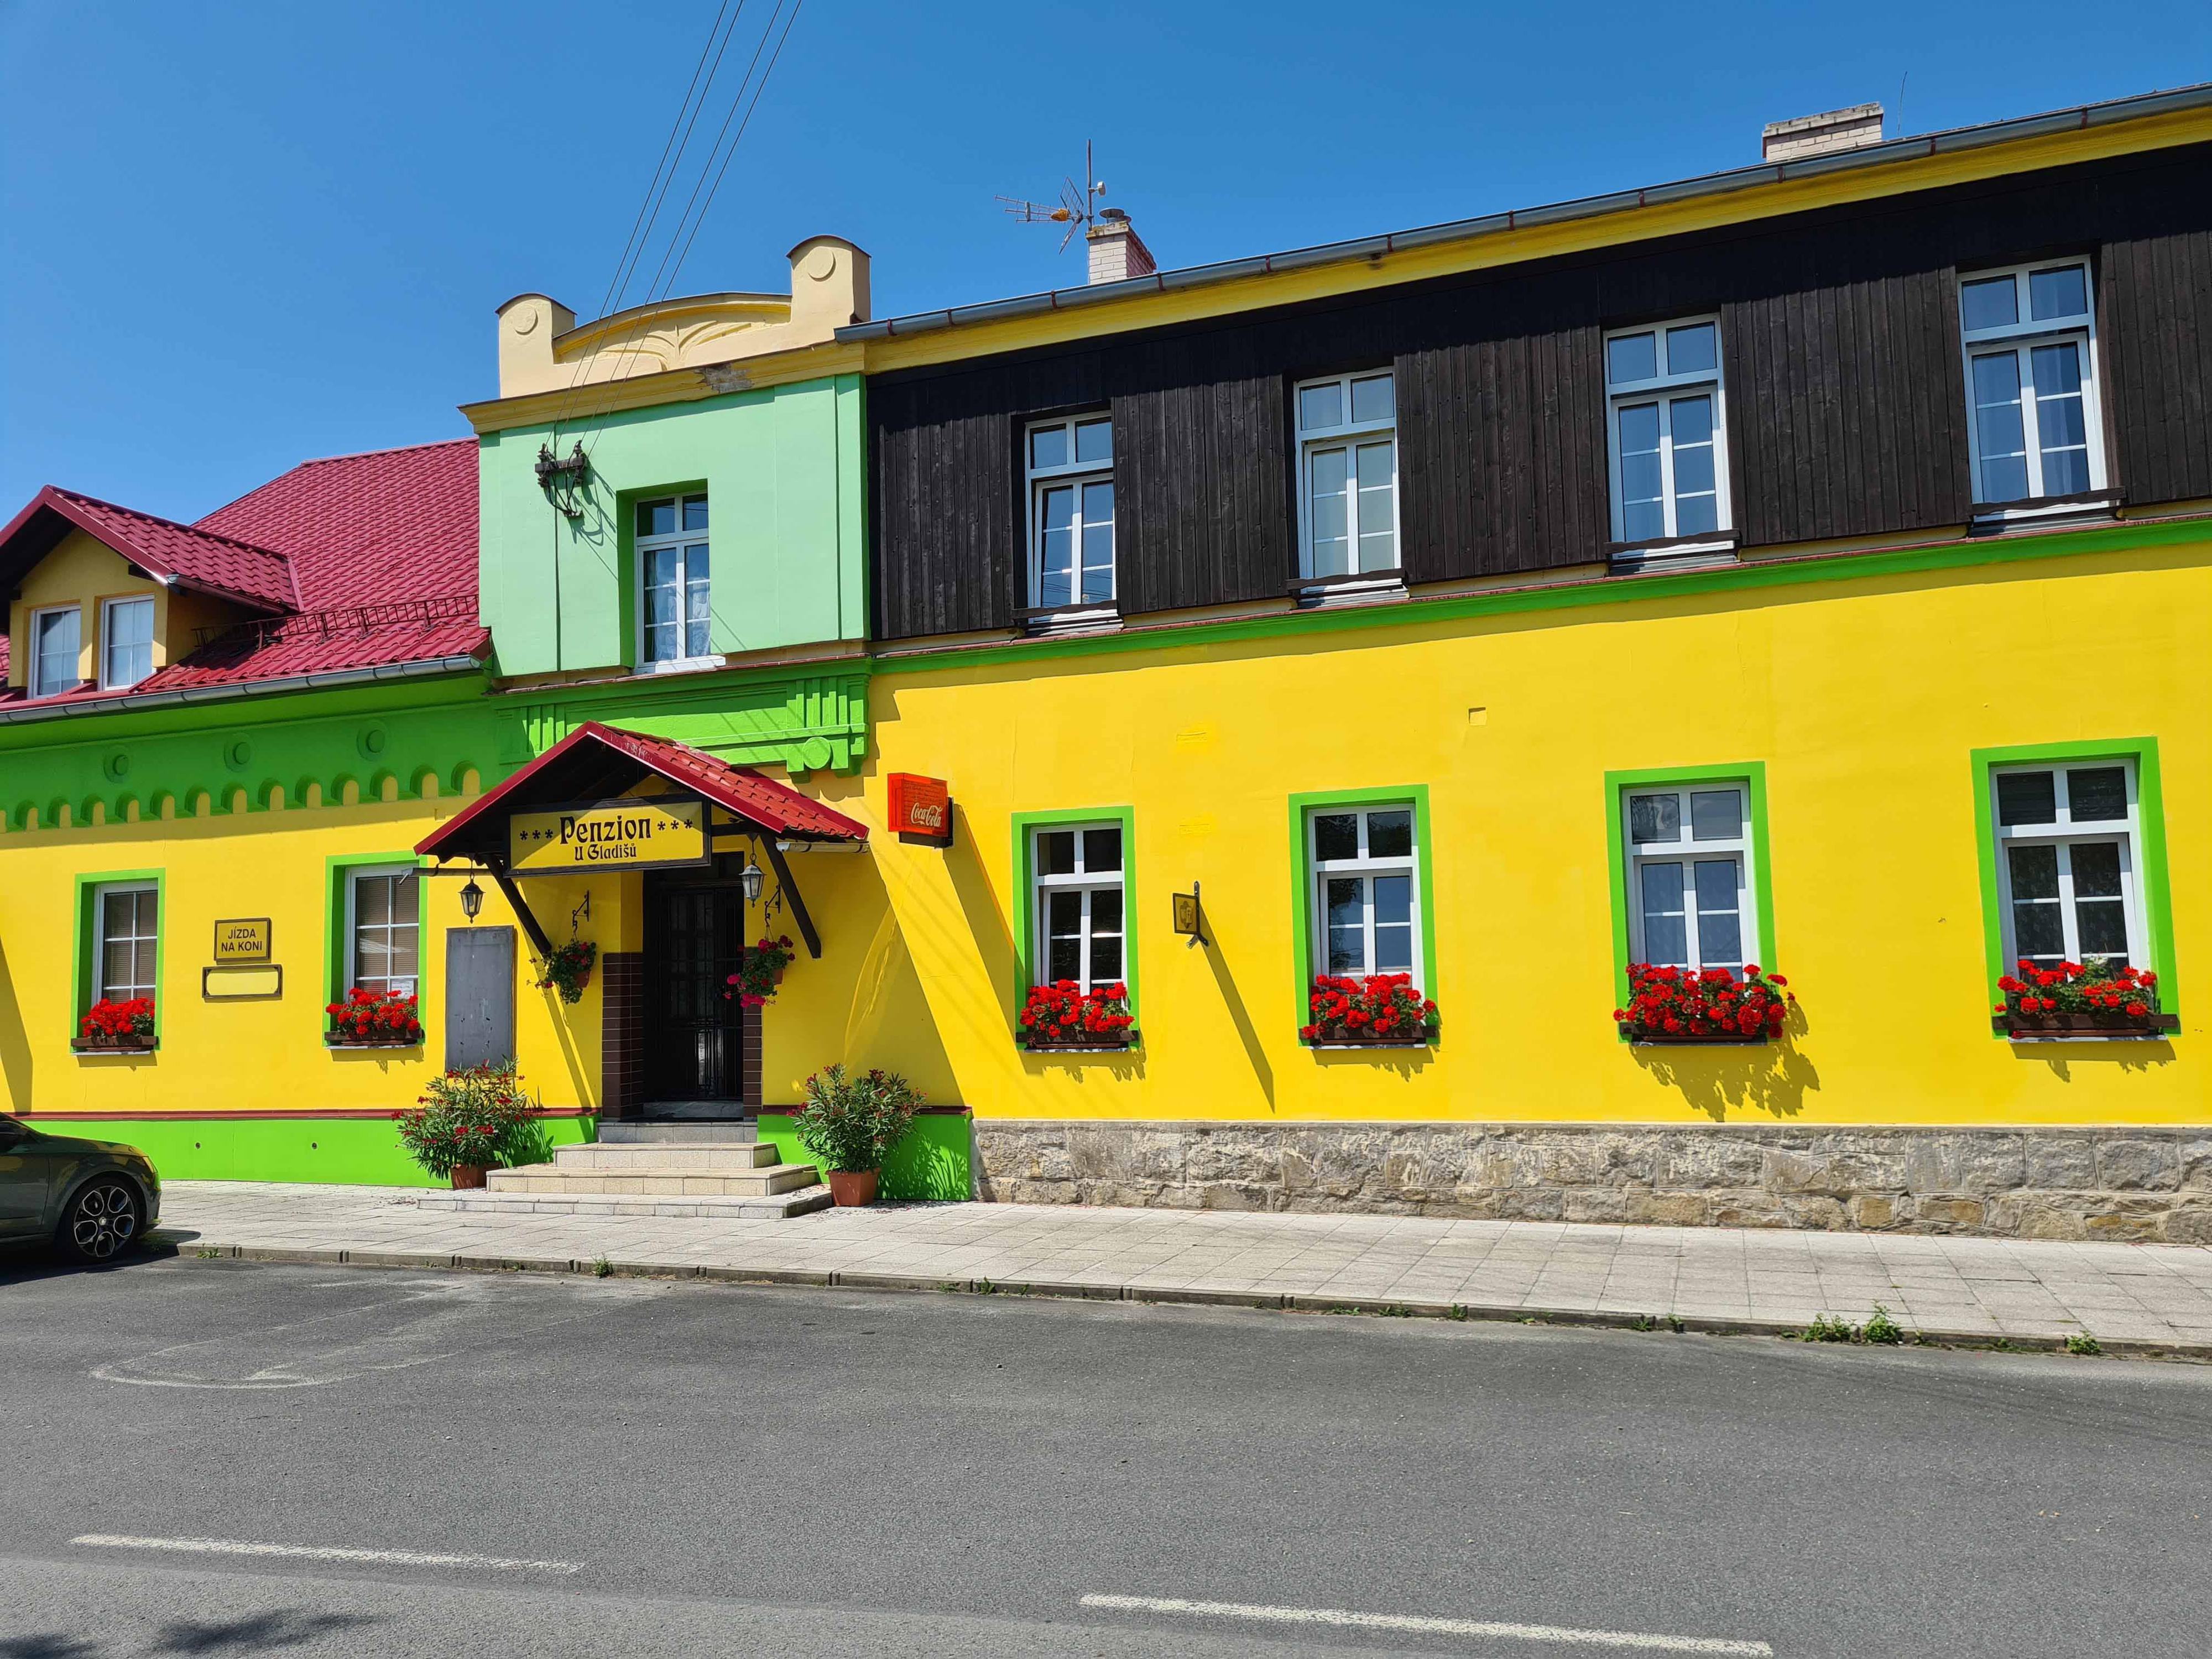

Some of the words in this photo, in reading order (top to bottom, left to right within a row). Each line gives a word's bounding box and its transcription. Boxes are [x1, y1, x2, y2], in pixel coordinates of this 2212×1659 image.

[560, 815, 651, 844] Penzion
[587, 843, 637, 860] Gladišů
[228, 926, 256, 939] JÍZDA
[221, 942, 234, 952] NA
[238, 941, 262, 951] KONI
